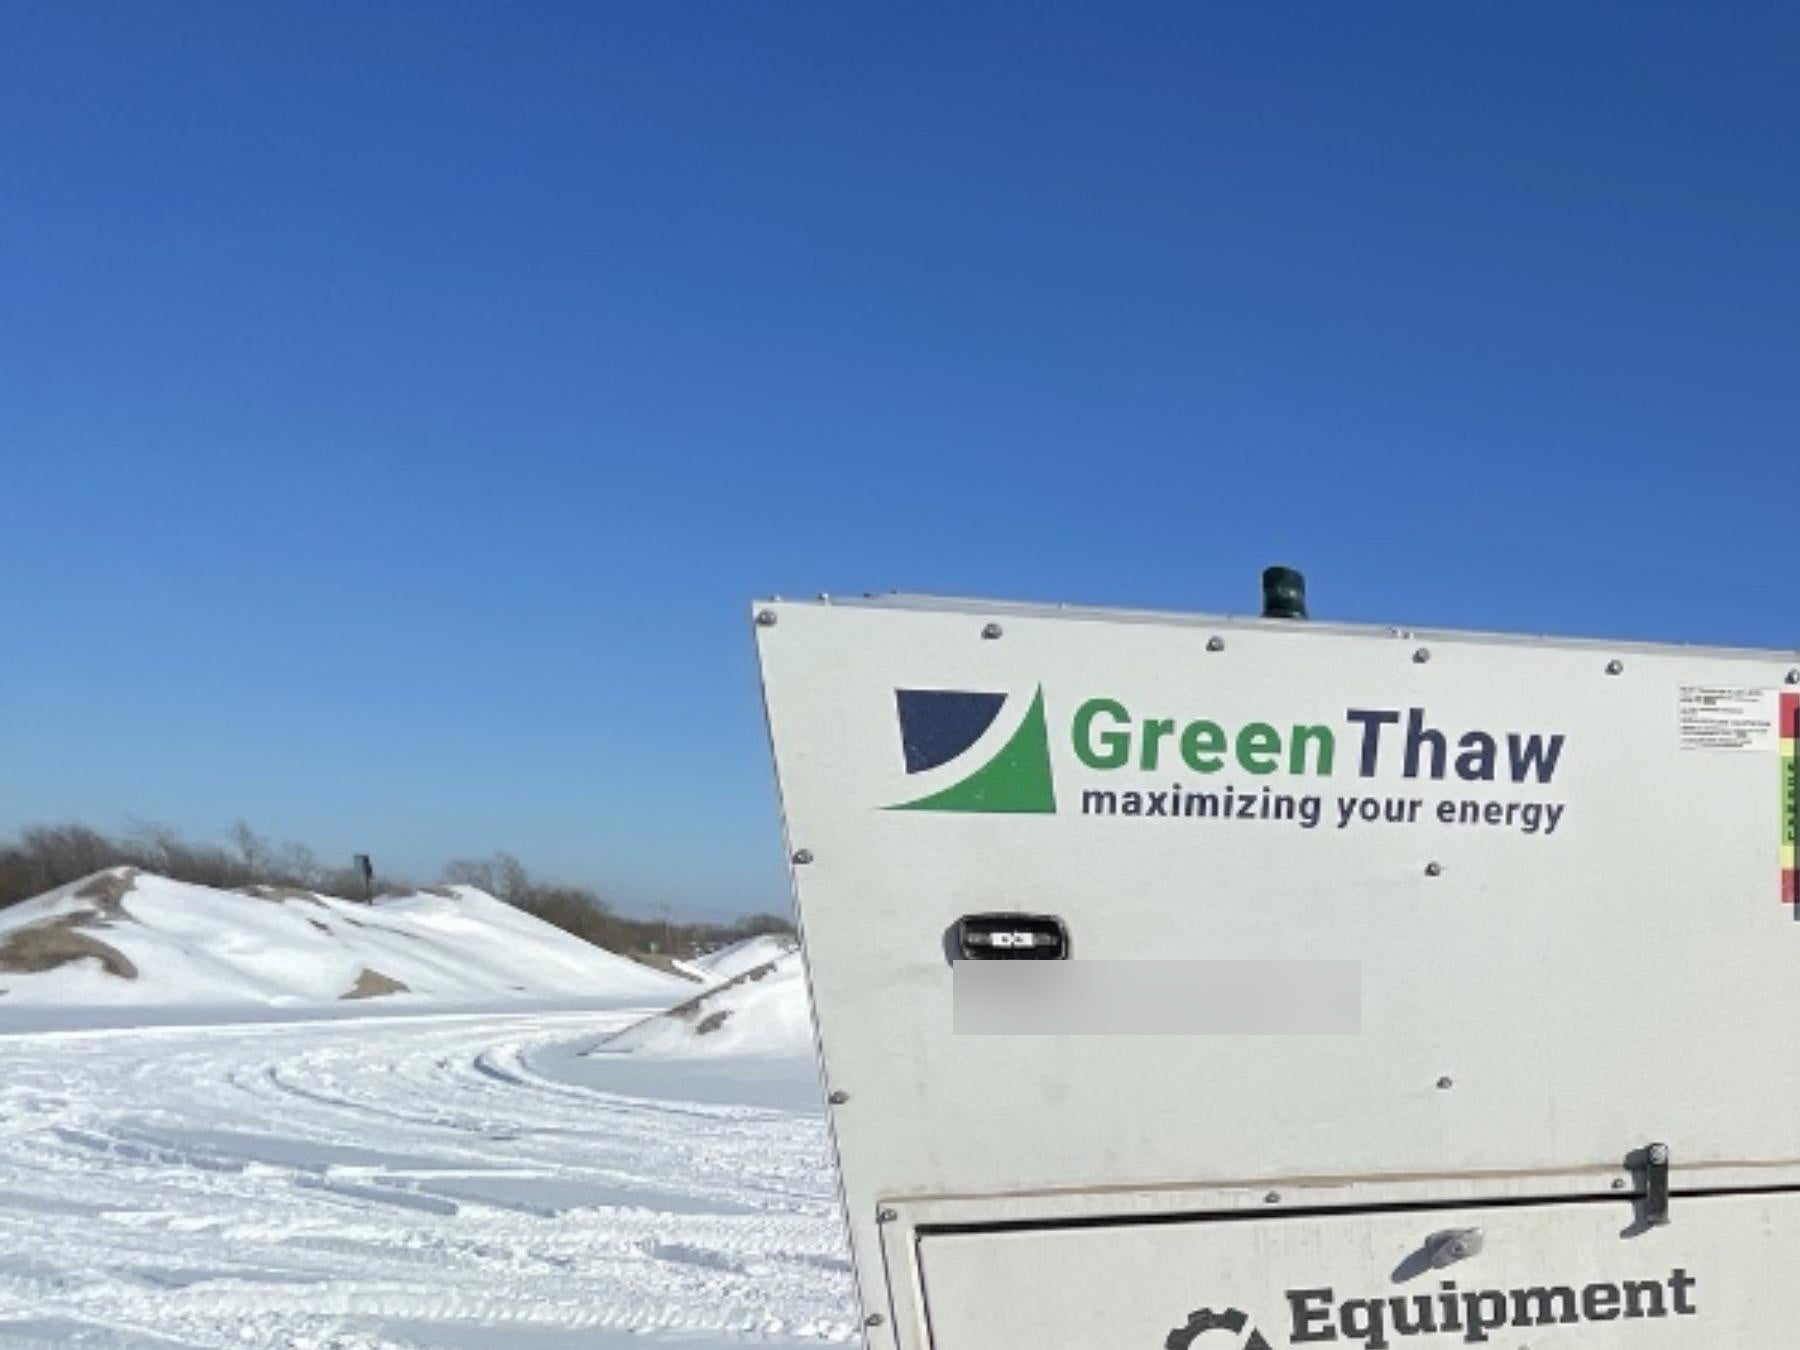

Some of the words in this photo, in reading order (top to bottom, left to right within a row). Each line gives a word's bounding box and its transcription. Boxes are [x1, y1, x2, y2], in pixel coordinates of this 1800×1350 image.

[1070, 697, 1566, 785] GreenThaw
[1081, 785, 1321, 829] maximizing
[1336, 793, 1422, 829] your
[1435, 796, 1565, 834] energy
[1286, 1268, 1697, 1350] Equipment
